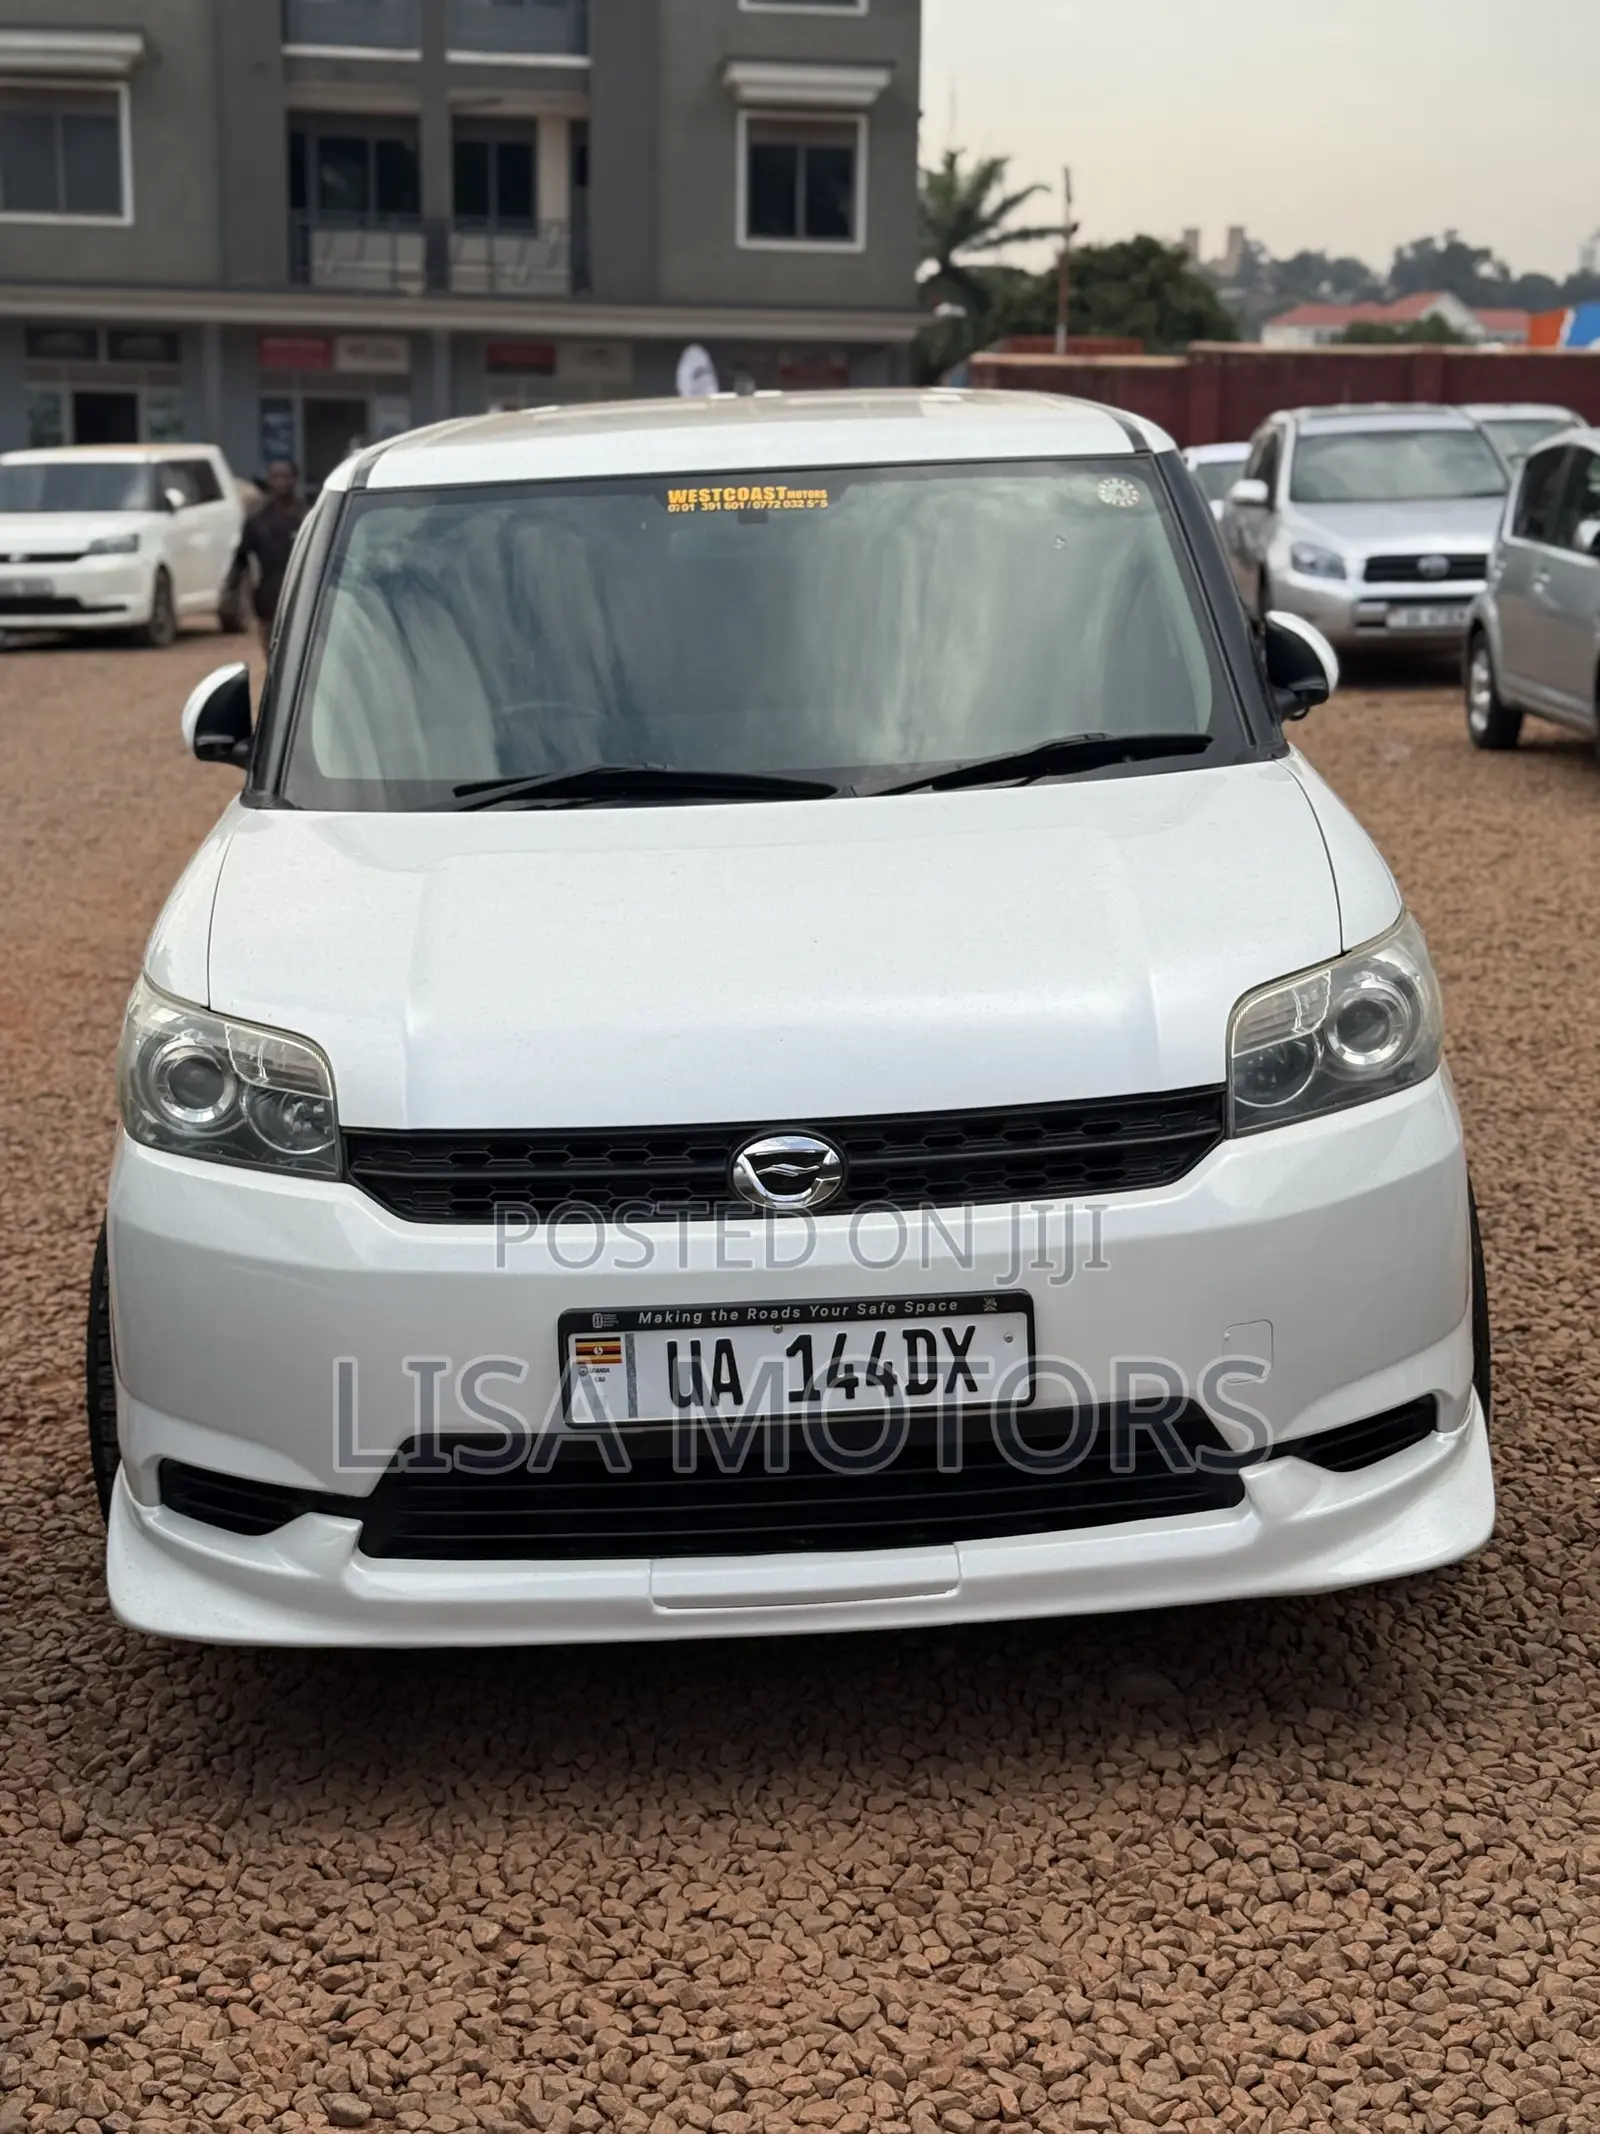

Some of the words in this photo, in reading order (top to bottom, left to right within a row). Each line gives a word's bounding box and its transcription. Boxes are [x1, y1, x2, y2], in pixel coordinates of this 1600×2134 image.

[668, 486, 787, 504] WESTCOAST
[787, 489, 828, 499] MOTORS
[752, 500, 781, 509] 0772
[638, 1312, 702, 1325] Making
[711, 1309, 739, 1321] the
[747, 1306, 801, 1320] Roads
[809, 1305, 850, 1317] Your
[857, 1302, 896, 1316] Safe
[904, 1300, 958, 1315] Space
[666, 1338, 744, 1408] UA
[785, 1325, 979, 1402] 144DX
